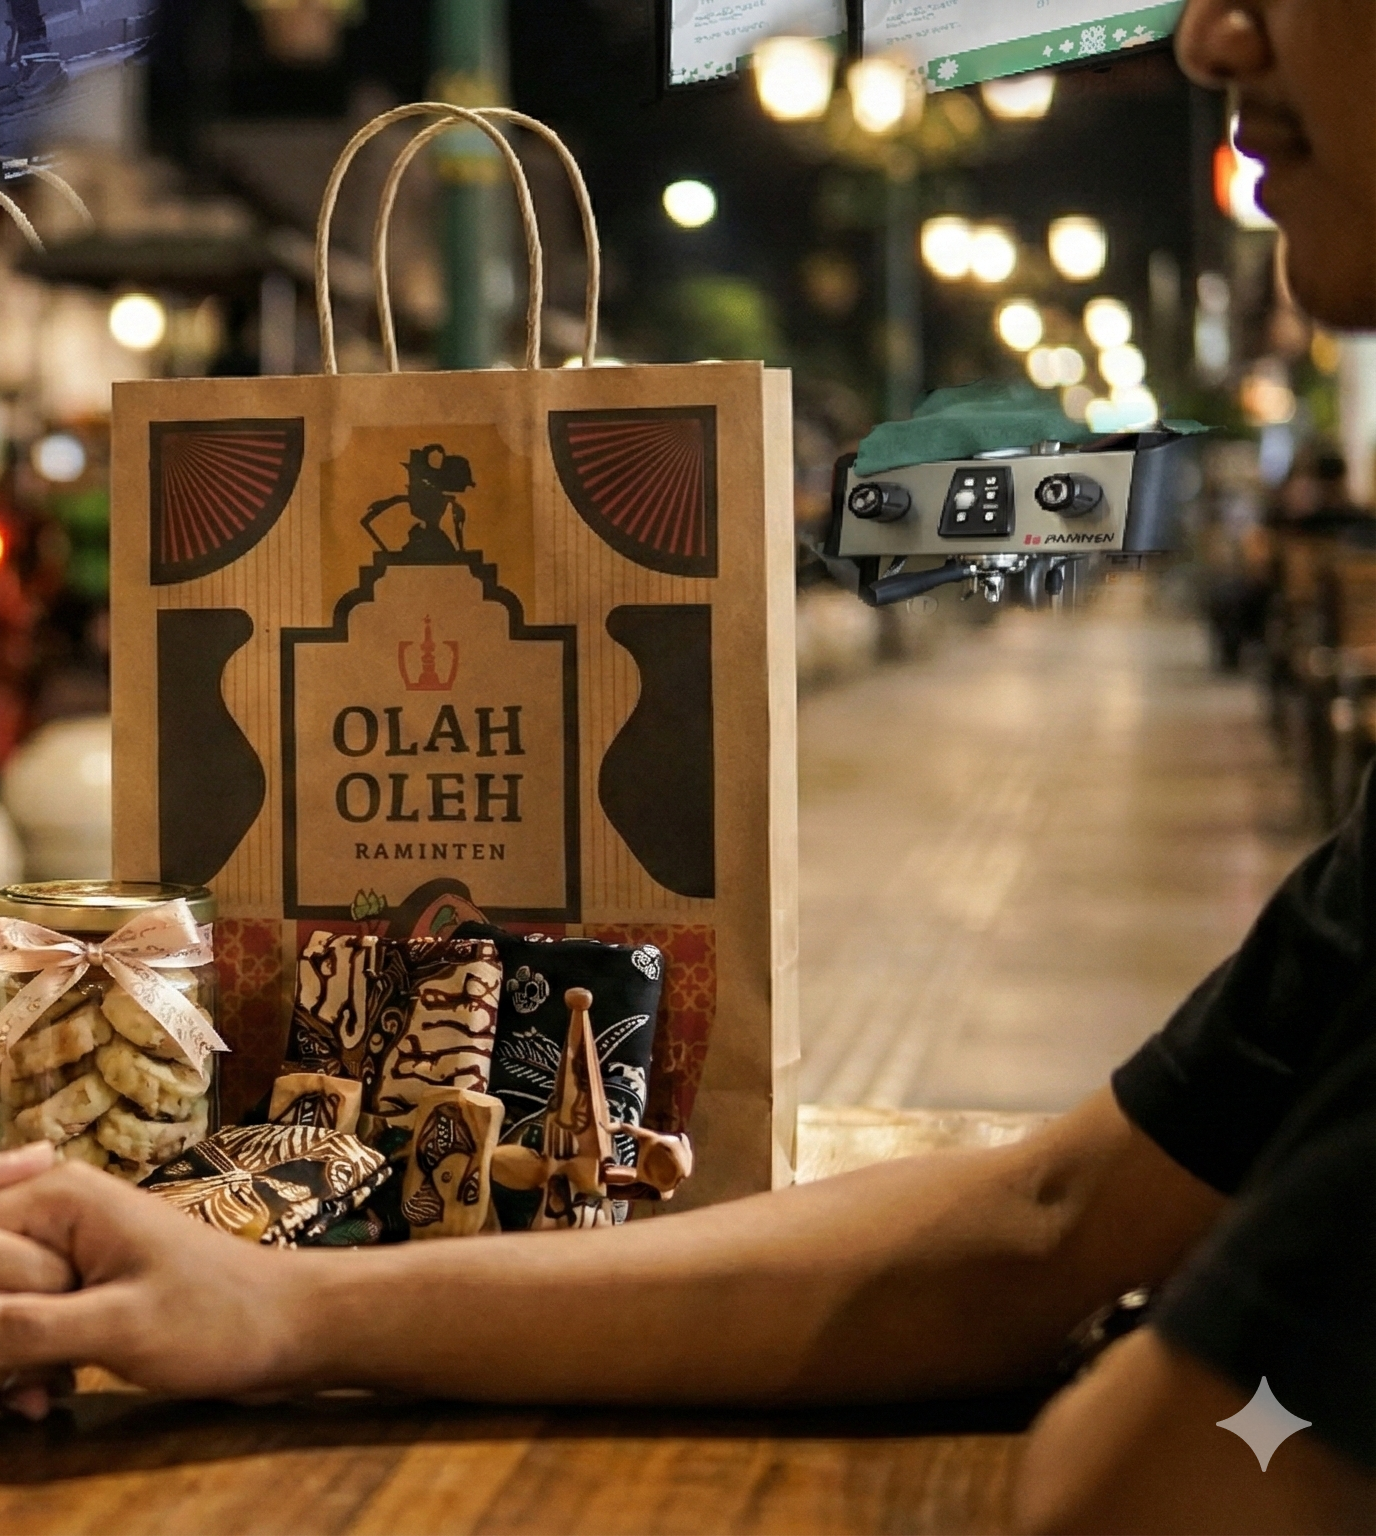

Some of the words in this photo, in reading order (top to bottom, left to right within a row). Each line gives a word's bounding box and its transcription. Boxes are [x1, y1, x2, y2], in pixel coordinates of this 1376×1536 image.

[332, 704, 526, 757] OLAH
[335, 772, 523, 823] OLEH
[354, 842, 506, 860] RAMINTEN
